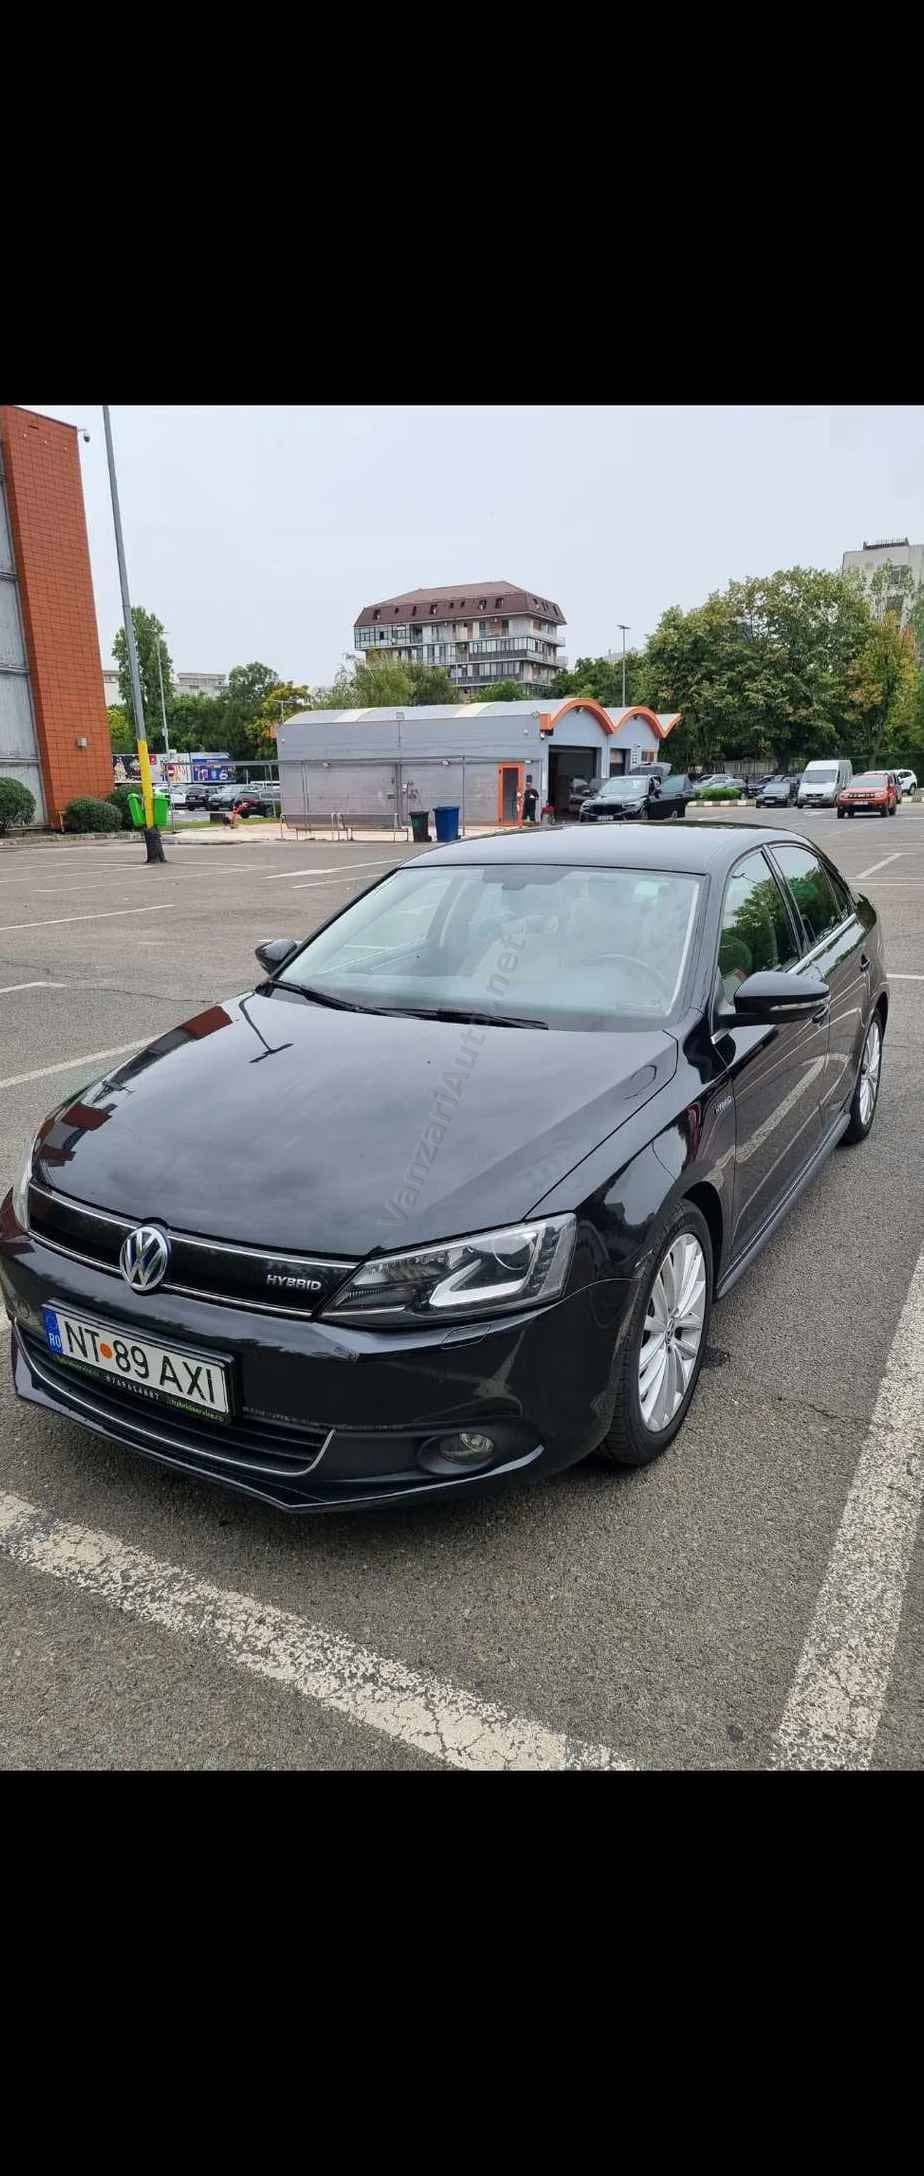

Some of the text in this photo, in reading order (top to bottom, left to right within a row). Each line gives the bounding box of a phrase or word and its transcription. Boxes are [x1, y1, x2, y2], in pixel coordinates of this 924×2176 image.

[265, 1273, 322, 1292] HYBRID
[49, 1332, 63, 1348] RO
[160, 1355, 216, 1403] AXI
